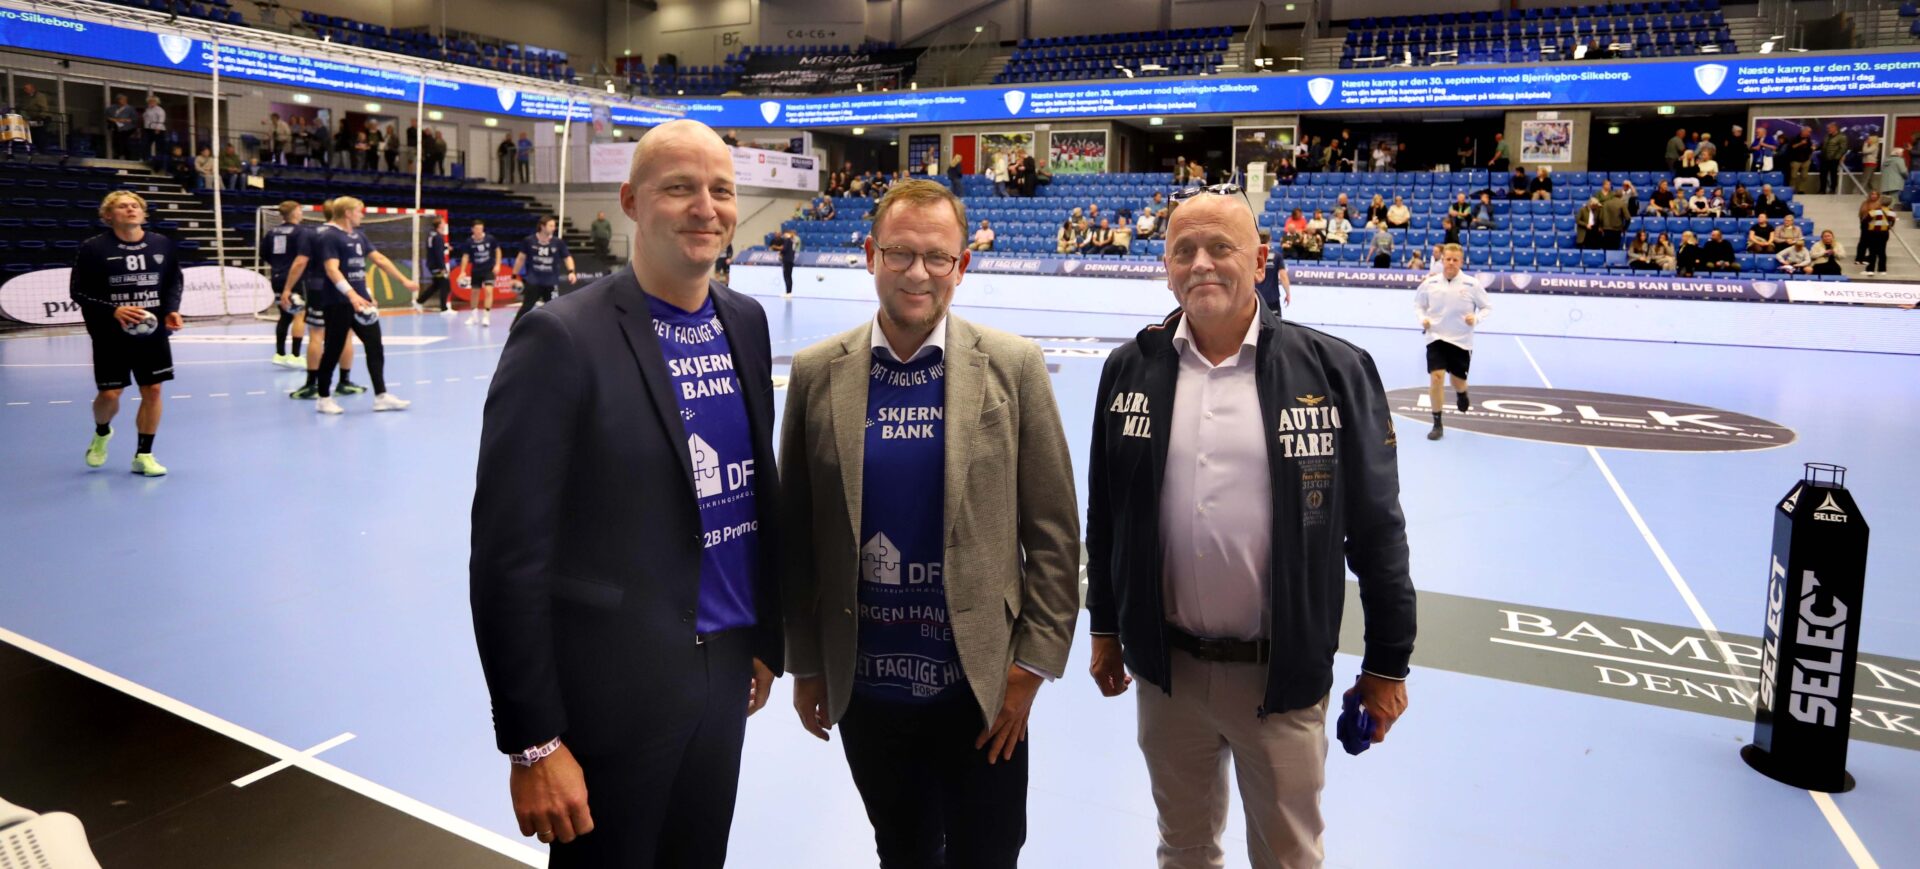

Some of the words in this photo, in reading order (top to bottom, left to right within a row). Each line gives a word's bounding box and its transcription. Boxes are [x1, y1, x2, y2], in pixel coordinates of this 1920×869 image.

[202, 42, 236, 54] Nste
[237, 47, 267, 60] kamp
[267, 50, 278, 61] er
[279, 54, 298, 64] den
[799, 55, 870, 65] MISENA
[1738, 66, 1775, 75] Næste
[1778, 65, 1811, 74] kamp
[1828, 63, 1851, 72] den
[1853, 62, 1871, 71] 30.
[1342, 80, 1370, 88] Næste
[1372, 79, 1398, 87] kamp
[1410, 78, 1428, 86] den
[1429, 77, 1443, 86] 30.
[1445, 75, 1496, 86] september
[1498, 74, 1520, 83] mod
[1522, 71, 1632, 84] Bjerringbro-Silkeborg.
[1743, 85, 1760, 93] den
[1761, 85, 1784, 94] giver
[1785, 84, 1811, 93] gratis
[1811, 83, 1846, 92] adgang
[1848, 82, 1858, 90] til
[1859, 81, 1916, 90] pokalbraget
[1775, 76, 1797, 84] billet
[1813, 75, 1850, 83] kampen
[1856, 74, 1875, 82] dag
[1112, 88, 1152, 97] september
[1360, 96, 1377, 104] giver
[1378, 95, 1397, 104] gratis
[1399, 95, 1424, 103] adgang
[1371, 88, 1387, 96] billet
[1399, 88, 1427, 96] kampen
[1432, 87, 1446, 96] dag
[125, 254, 146, 271] 81
[1084, 263, 1119, 272] DENNE
[1120, 264, 1153, 273] PLADS
[1295, 270, 1334, 279] DENNE
[1337, 271, 1376, 281] PLADS
[1378, 272, 1404, 281] KAN
[1540, 277, 1587, 288] DENNE
[1590, 279, 1635, 290] PLADS
[1638, 282, 1668, 291] KAN
[1672, 282, 1713, 292] BLIVE
[1716, 284, 1743, 294] DIN
[652, 318, 671, 339] DET
[675, 323, 714, 345] FAGLIGE
[668, 353, 734, 378] SKJERN
[871, 362, 888, 381] DET
[888, 369, 928, 387] FAGLIGE
[681, 377, 735, 400] BANK
[877, 406, 943, 424] SKJERN
[881, 424, 935, 440] BANK
[1123, 415, 1151, 438] MIL
[1580, 419, 1666, 430] RUDOLF
[1672, 427, 1731, 436] LOLK
[1279, 432, 1334, 458] TARE
[1813, 512, 1848, 523] SELECT
[704, 530, 721, 549] 2B
[723, 520, 759, 542] Promo
[921, 623, 952, 641] BILE
[1761, 555, 1788, 713] SELECT
[1788, 569, 1849, 729] SELECT
[876, 658, 938, 685] FAGLIGE
